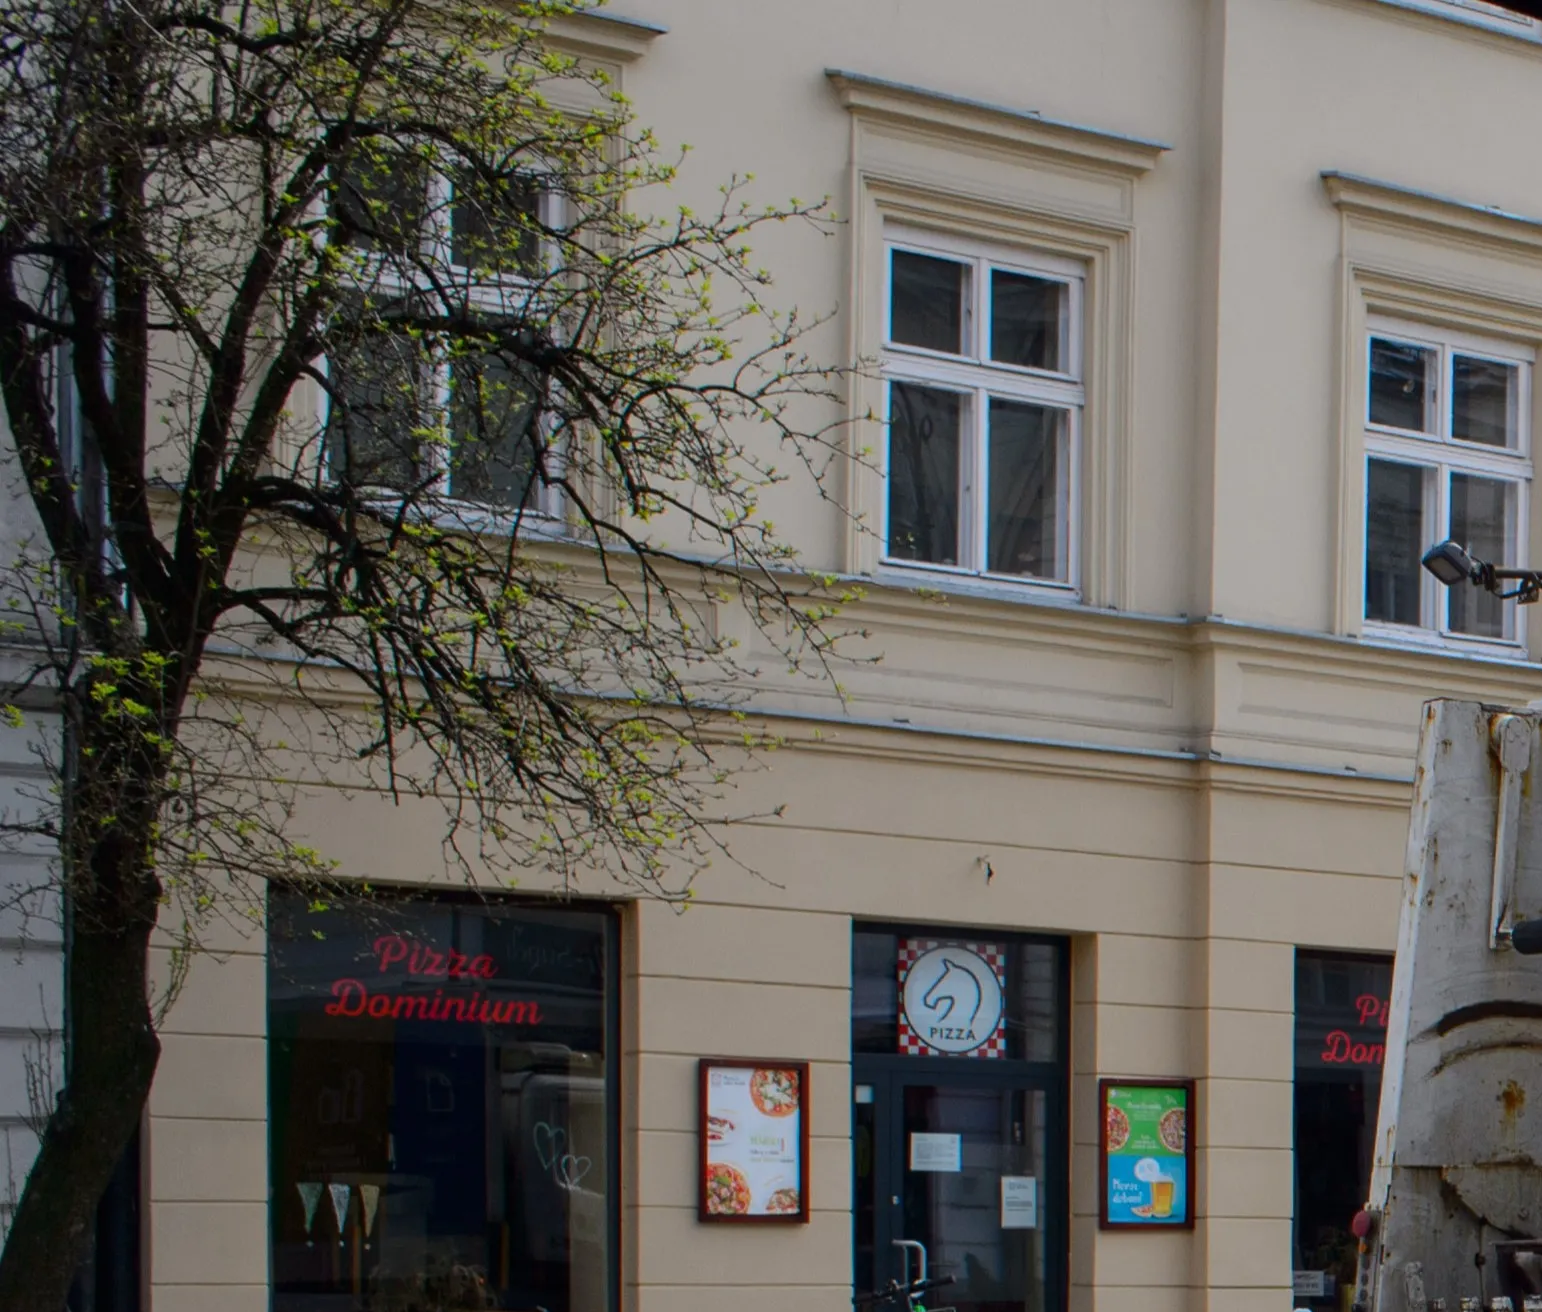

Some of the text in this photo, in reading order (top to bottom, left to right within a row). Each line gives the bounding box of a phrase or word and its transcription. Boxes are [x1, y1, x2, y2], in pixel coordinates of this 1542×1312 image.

[372, 936, 498, 979] Pizza
[325, 978, 543, 1025] Dominium
[1355, 993, 1391, 1027] Pi
[929, 1026, 976, 1041] PIZZA
